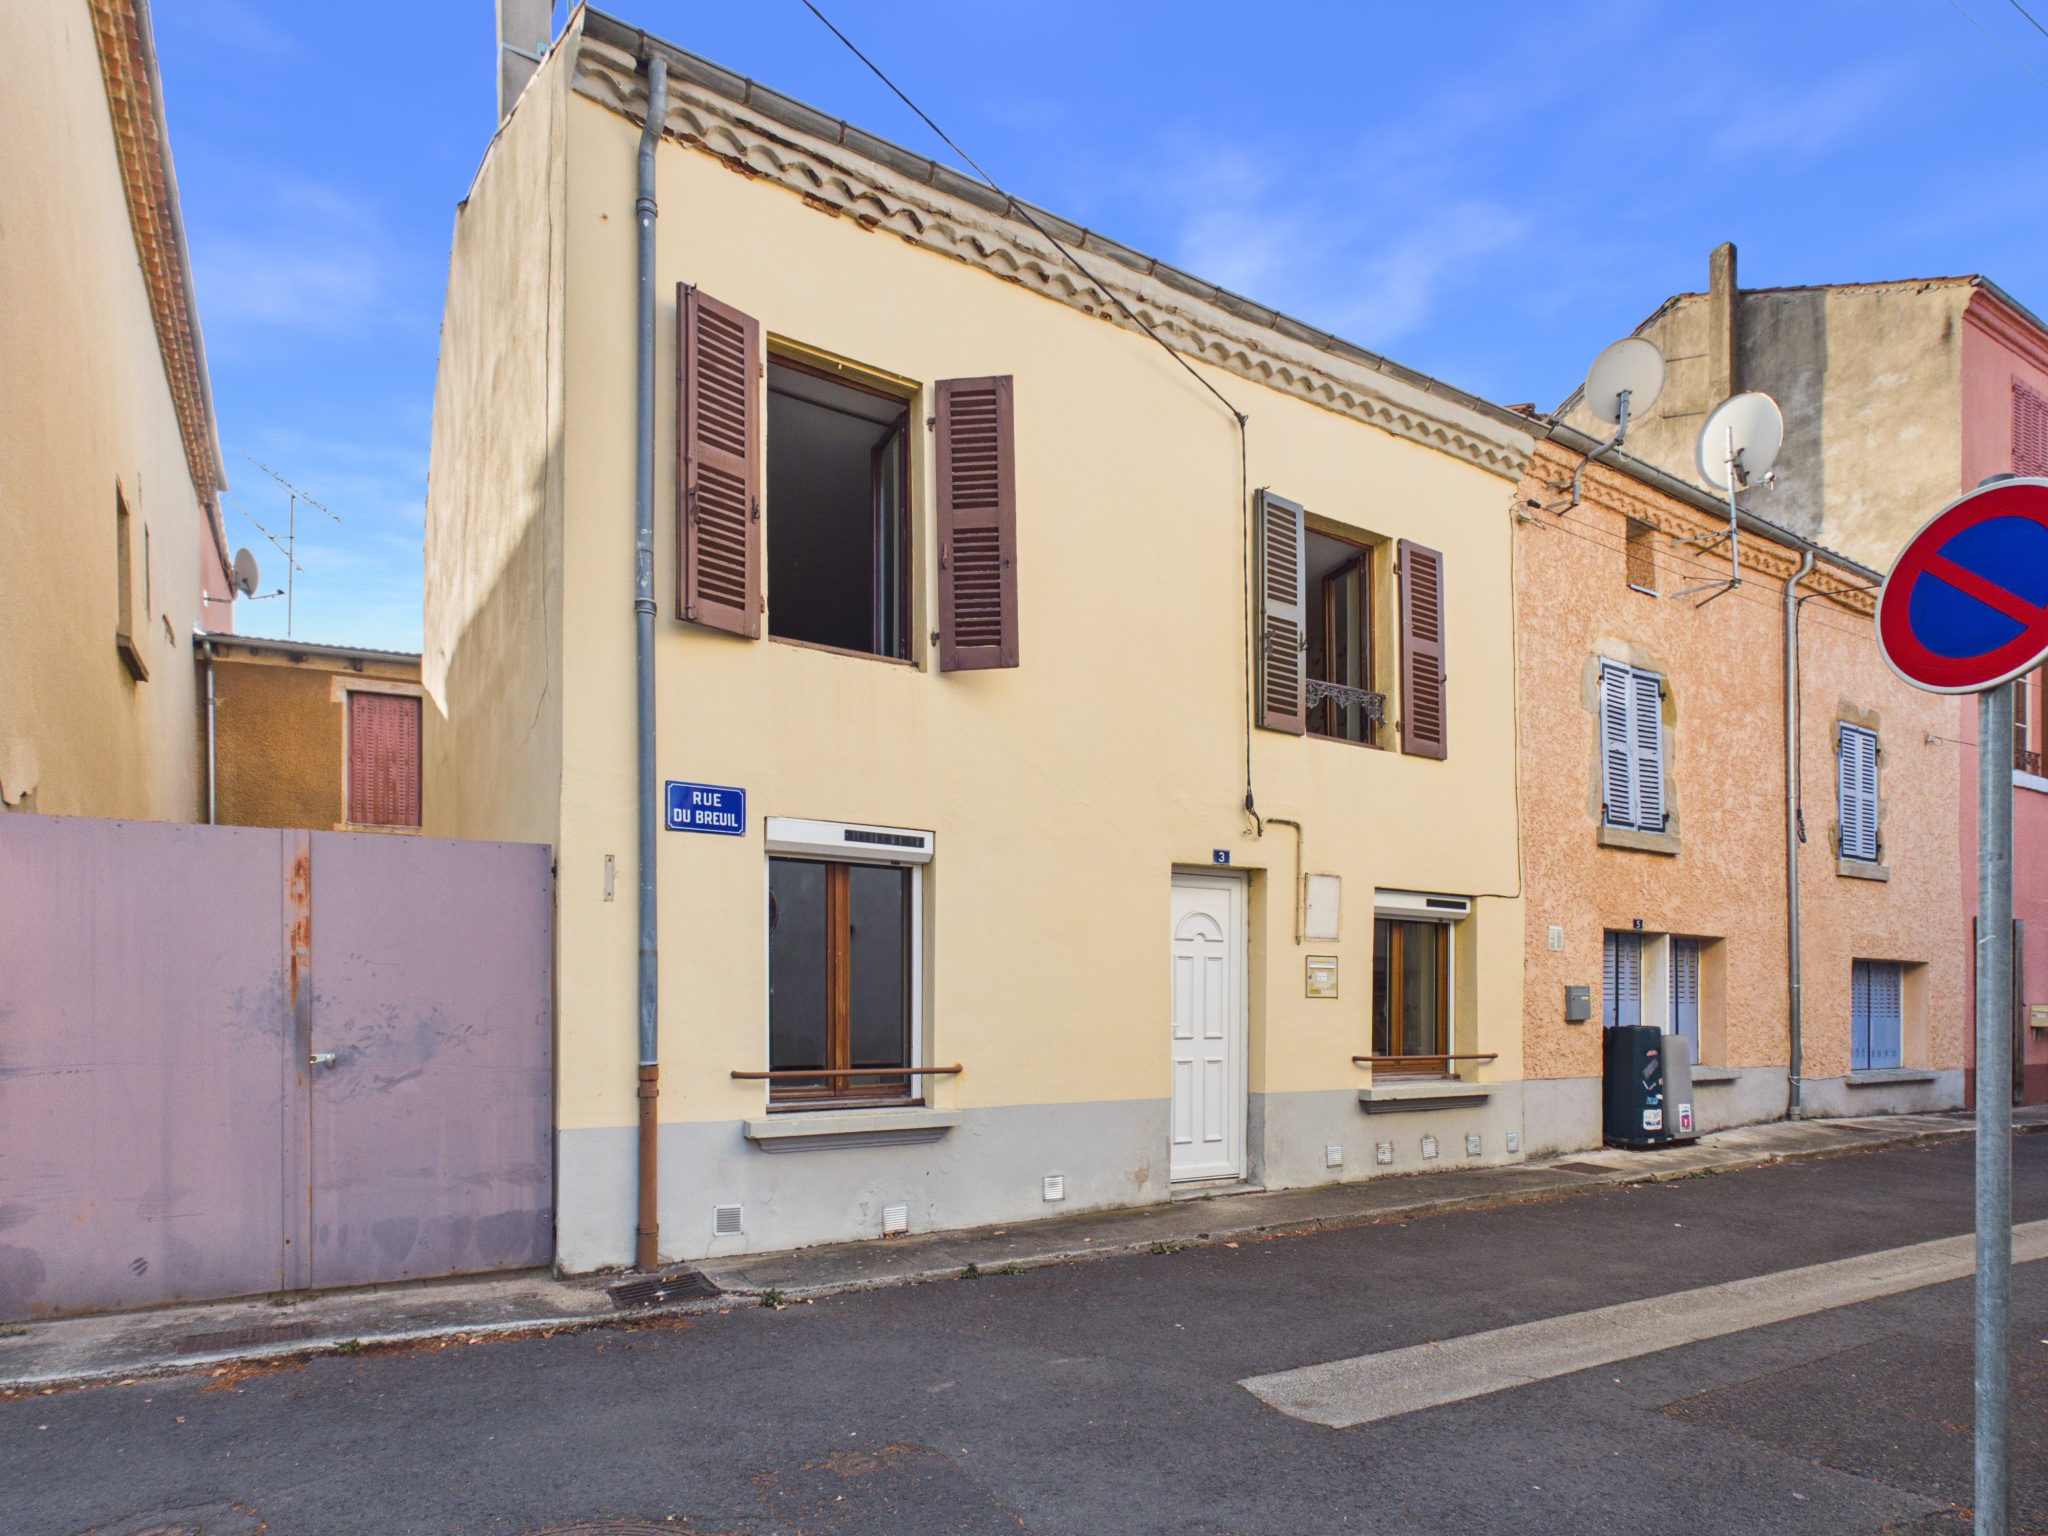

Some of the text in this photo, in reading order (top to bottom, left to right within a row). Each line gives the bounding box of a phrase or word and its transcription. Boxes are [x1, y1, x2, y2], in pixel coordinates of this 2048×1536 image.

[692, 791, 722, 807] RUE
[673, 808, 738, 827] DU BREUIL
[1219, 851, 1225, 863] 3
[1636, 920, 1641, 929] 5
